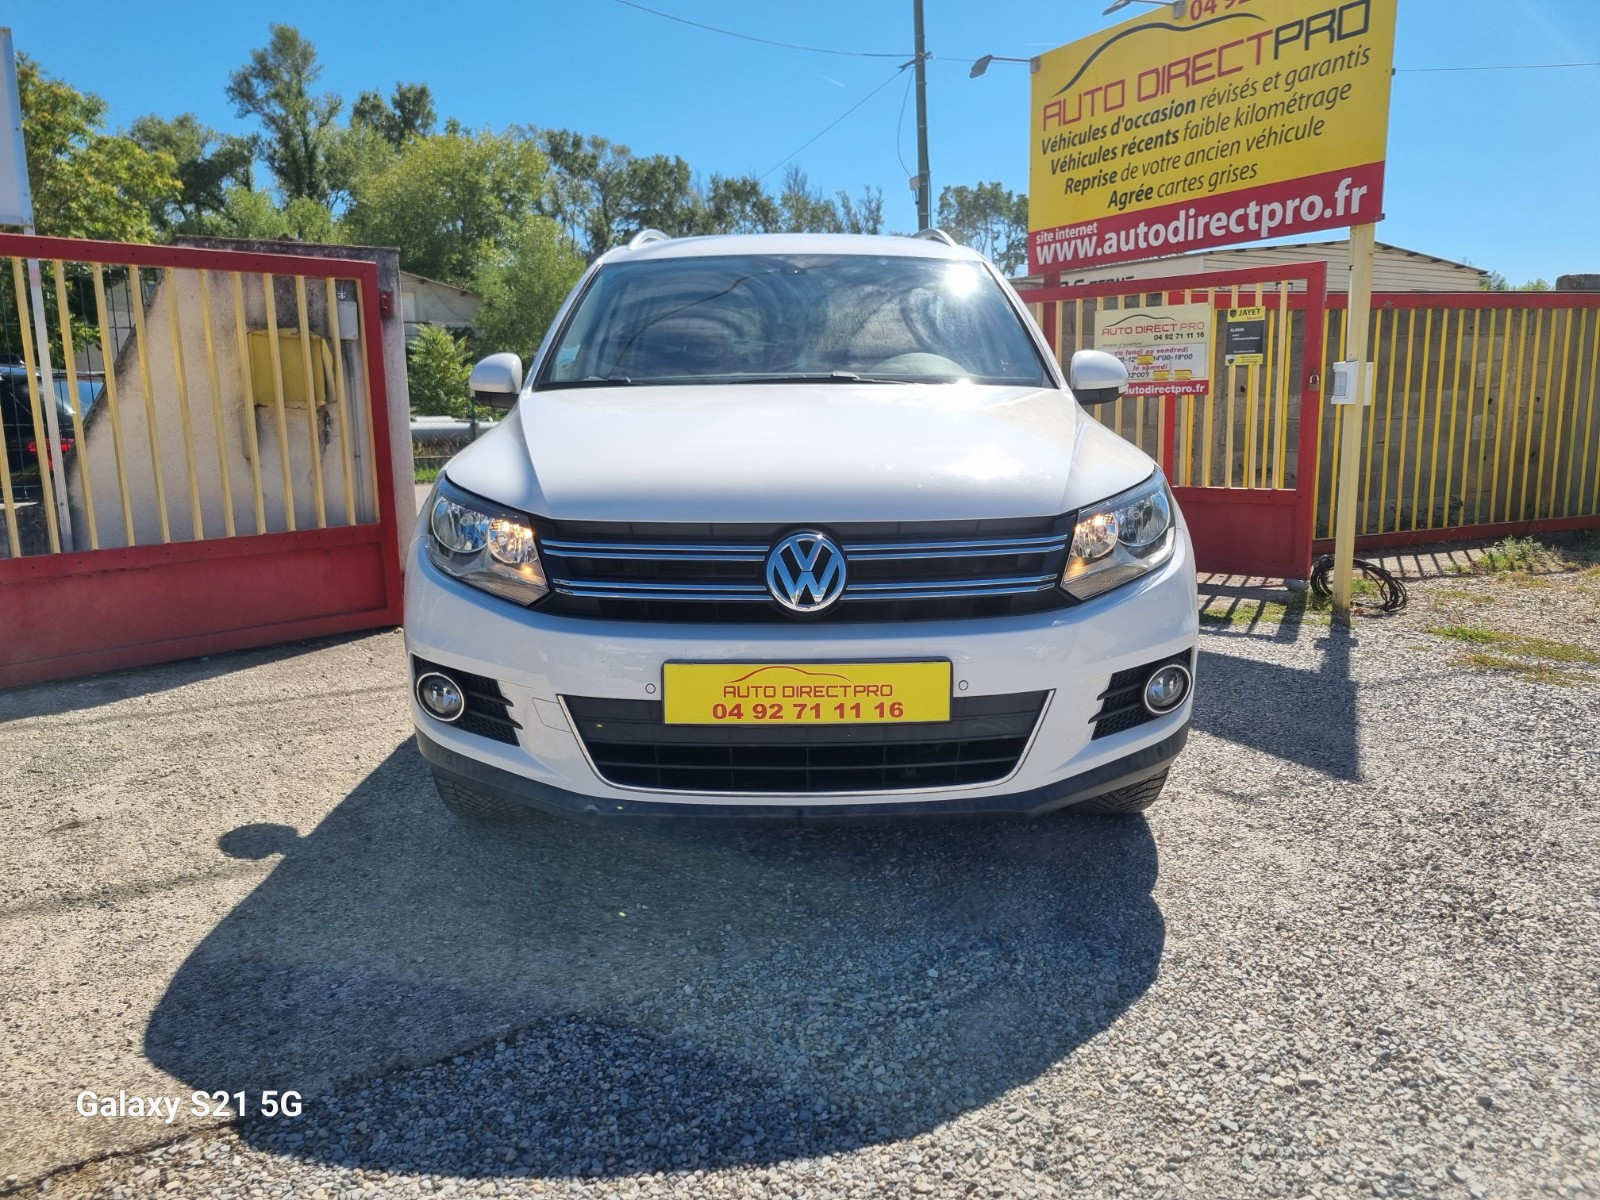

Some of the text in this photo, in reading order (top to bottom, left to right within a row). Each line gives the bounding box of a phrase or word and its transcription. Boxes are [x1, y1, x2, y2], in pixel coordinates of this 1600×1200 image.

[1042, 44, 1371, 155] Véhicules d'occasion révisés et garantis
[1043, 79, 1126, 132] AUTO
[1051, 83, 1352, 175] Véhicules récents faible kilométrage
[1064, 115, 1325, 195] Reprise de votre ancien véhicule
[1107, 161, 1259, 211] Agrée cartes grises
[1035, 177, 1368, 266] www.autodirectpro.fr
[1035, 222, 1098, 245] site internet
[1238, 308, 1261, 316] JAYET
[1101, 326, 1133, 336] AUTO
[1156, 346, 1189, 354] vendredi
[1141, 363, 1168, 371] samedi
[723, 684, 777, 699] AUTO
[712, 701, 904, 720] 04 92 71 11 16
